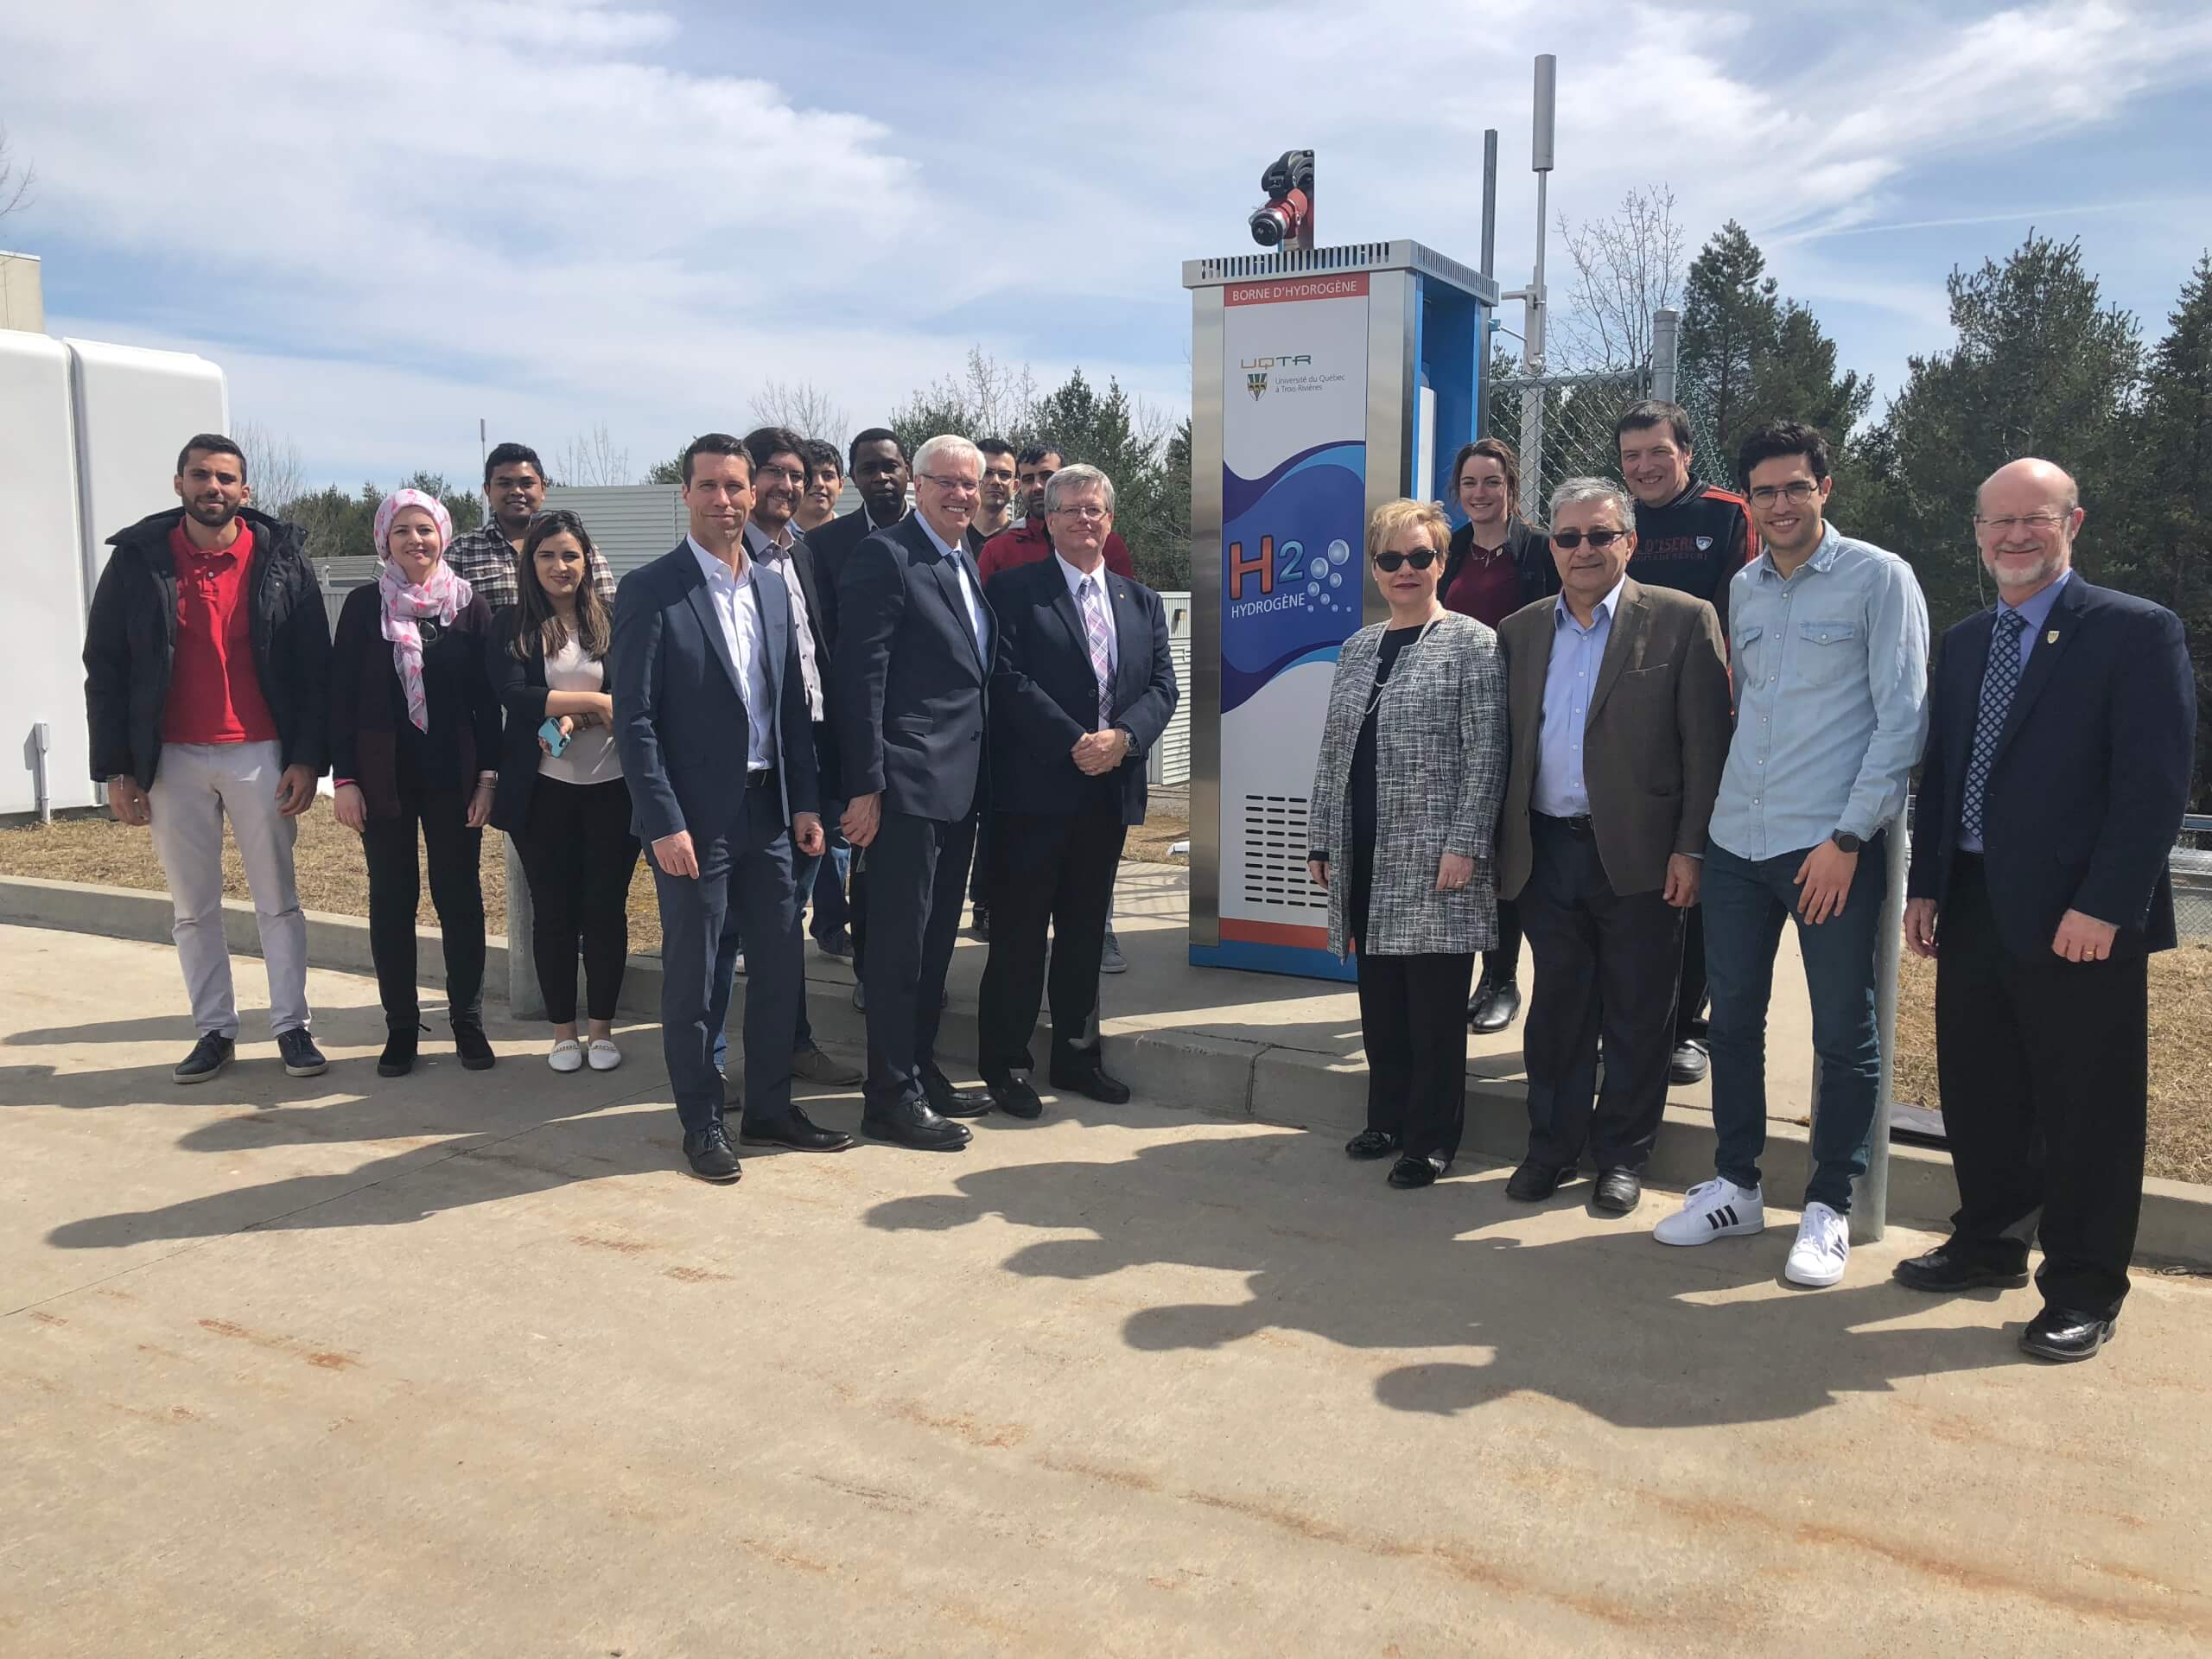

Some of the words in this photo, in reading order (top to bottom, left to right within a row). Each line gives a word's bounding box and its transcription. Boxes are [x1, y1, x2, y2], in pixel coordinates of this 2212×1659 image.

[1232, 287, 1270, 302] BORNE
[1274, 280, 1357, 297] D'HYDROGÈNE
[1240, 354, 1312, 370] UQTR
[1274, 375, 1307, 385] Université
[1319, 373, 1345, 383] Québec
[1229, 534, 1305, 601] H2
[1231, 593, 1306, 619] HYDROGÈNE
